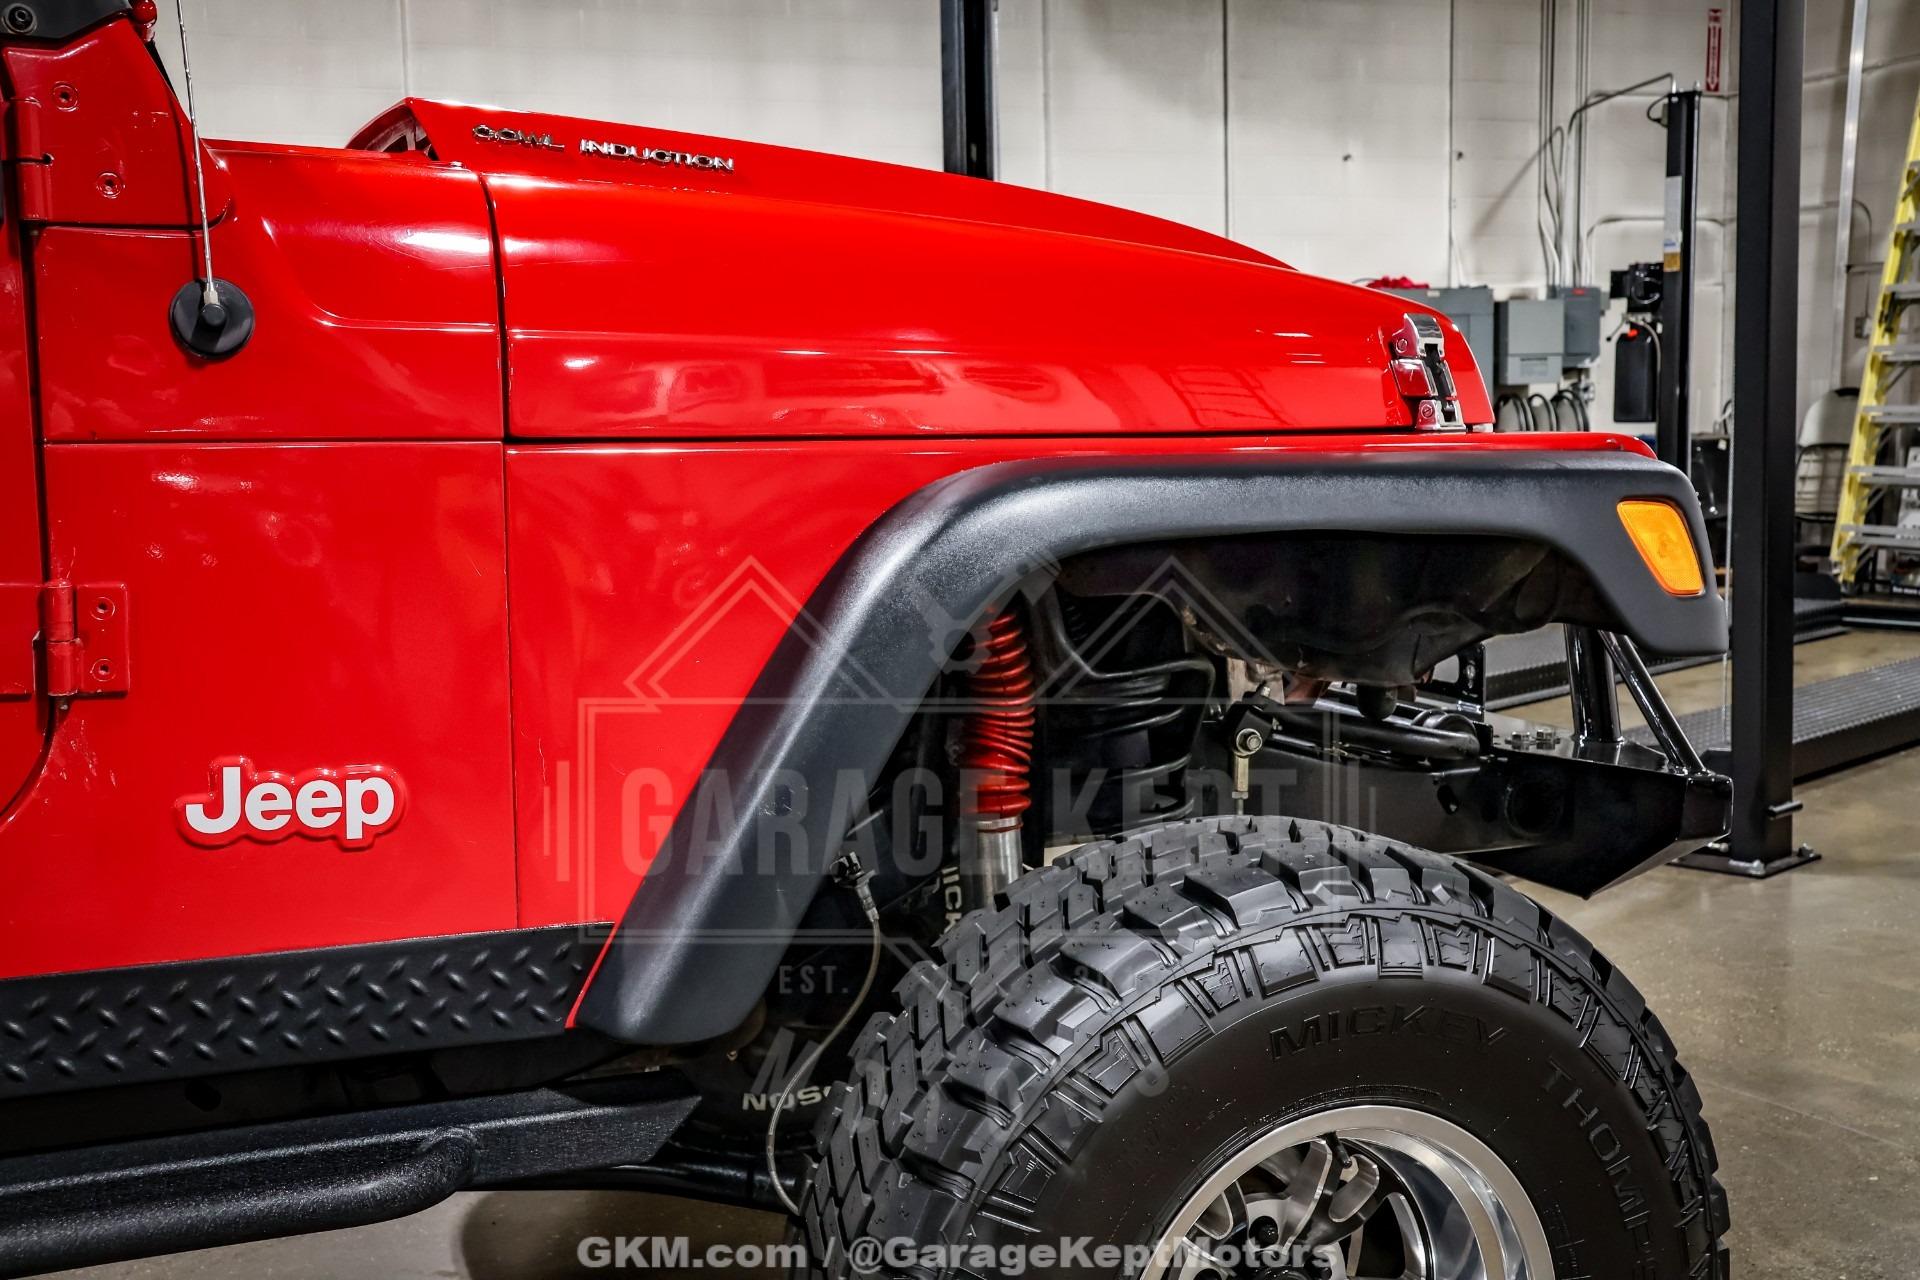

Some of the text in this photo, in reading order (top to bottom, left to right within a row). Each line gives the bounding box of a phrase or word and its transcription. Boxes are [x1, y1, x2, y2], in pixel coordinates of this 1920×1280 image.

[472, 124, 735, 173] COWL INDUCTION
[185, 766, 395, 840] Jeep
[1268, 1002, 1512, 1061] MICKEY
